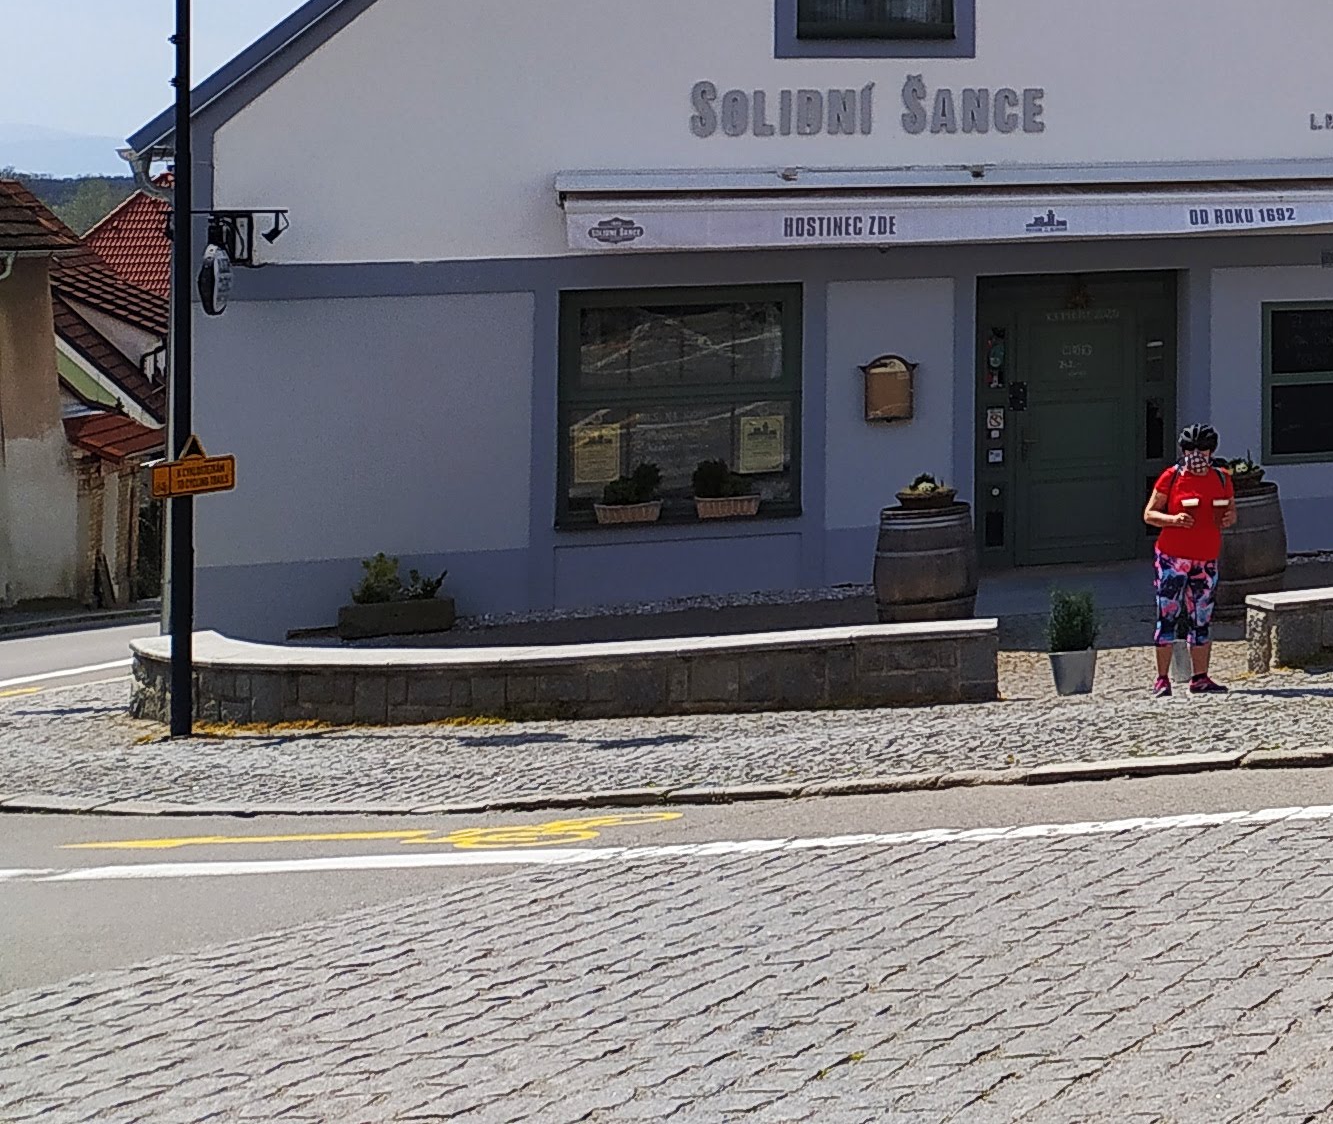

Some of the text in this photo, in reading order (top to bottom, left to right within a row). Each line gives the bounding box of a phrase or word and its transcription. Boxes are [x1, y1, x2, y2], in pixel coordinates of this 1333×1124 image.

[690, 74, 1044, 138] SOLIDNÍ ŠANCE
[784, 216, 896, 237] HOSTINEC ZDE
[1189, 207, 1296, 225] OD ROKU 1692
